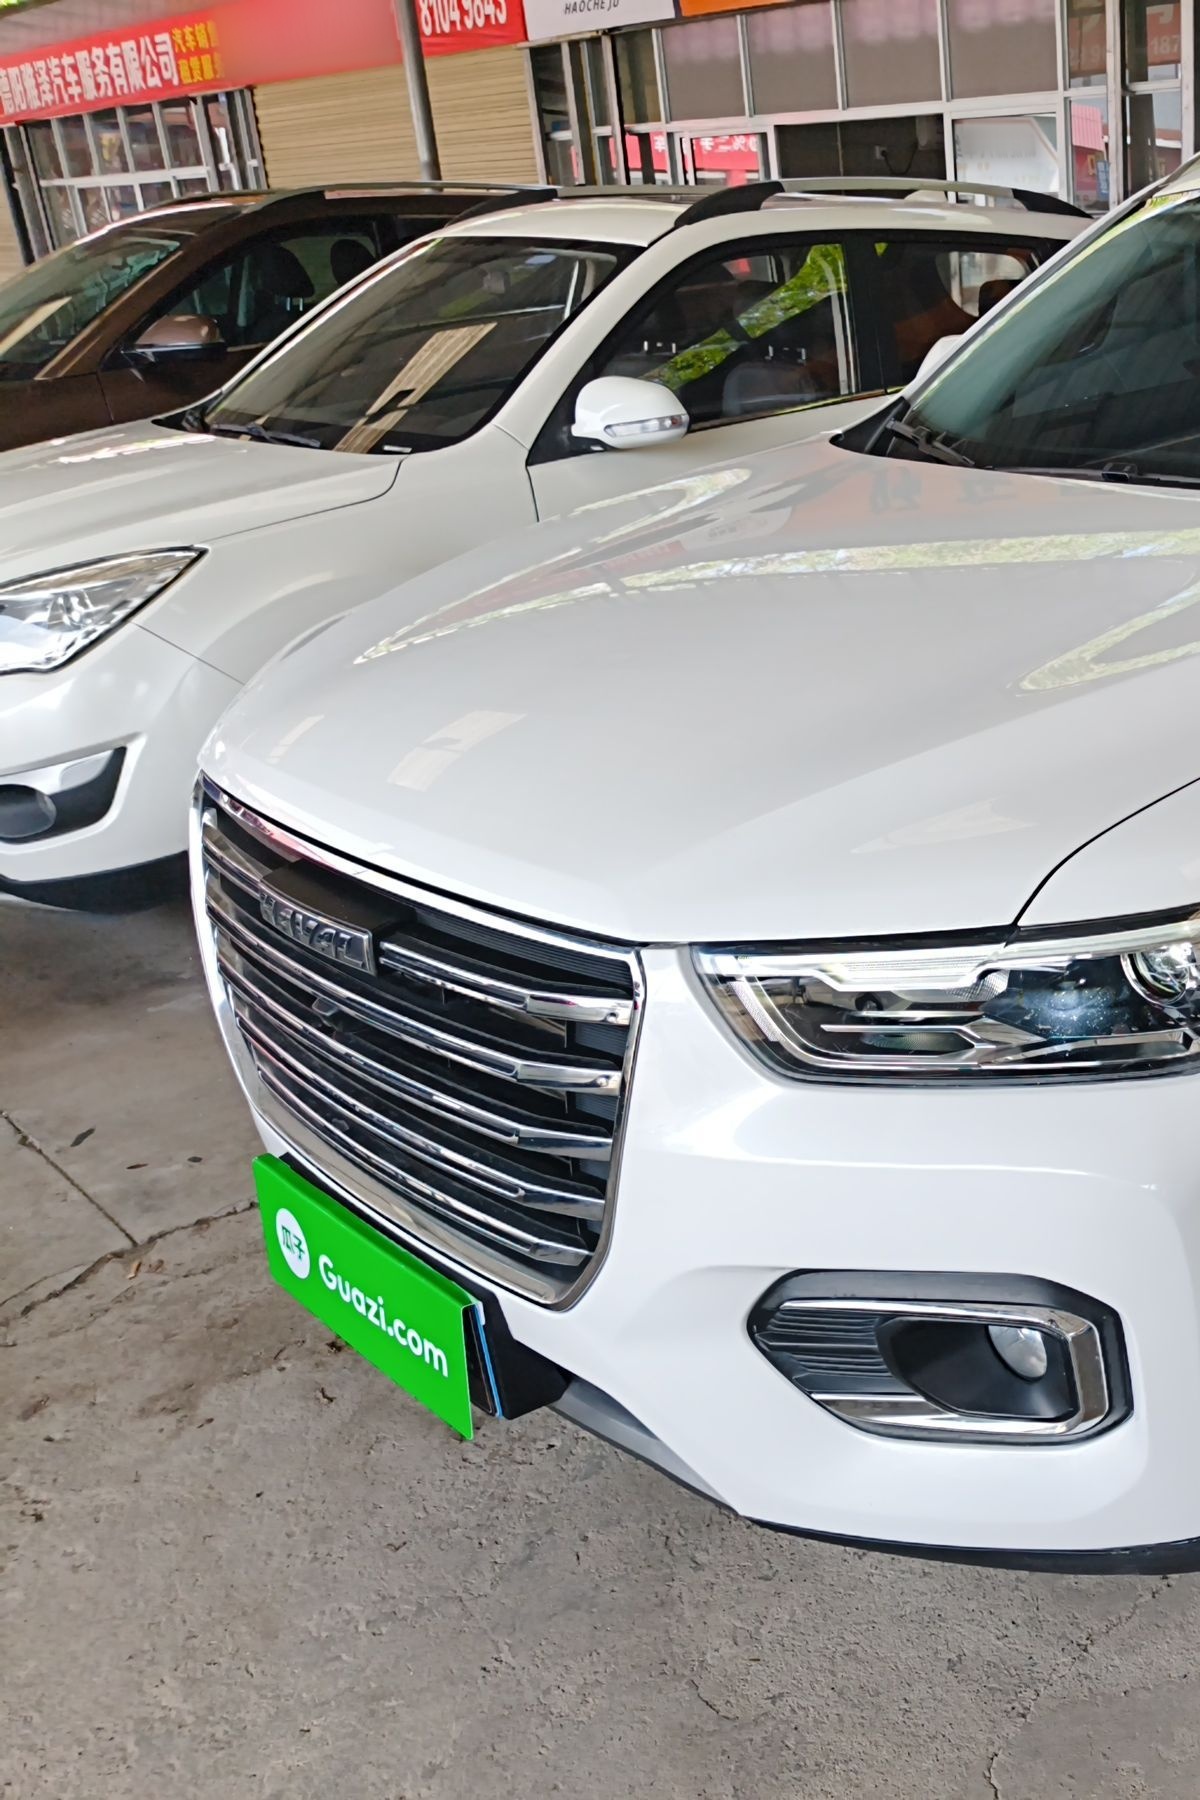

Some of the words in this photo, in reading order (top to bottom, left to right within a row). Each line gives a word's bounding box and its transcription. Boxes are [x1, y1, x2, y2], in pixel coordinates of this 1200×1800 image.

[564, 0, 606, 15] HAOCHE
[280, 1224, 306, 1261] 瓜子
[318, 1253, 449, 1378] Guazi.com
